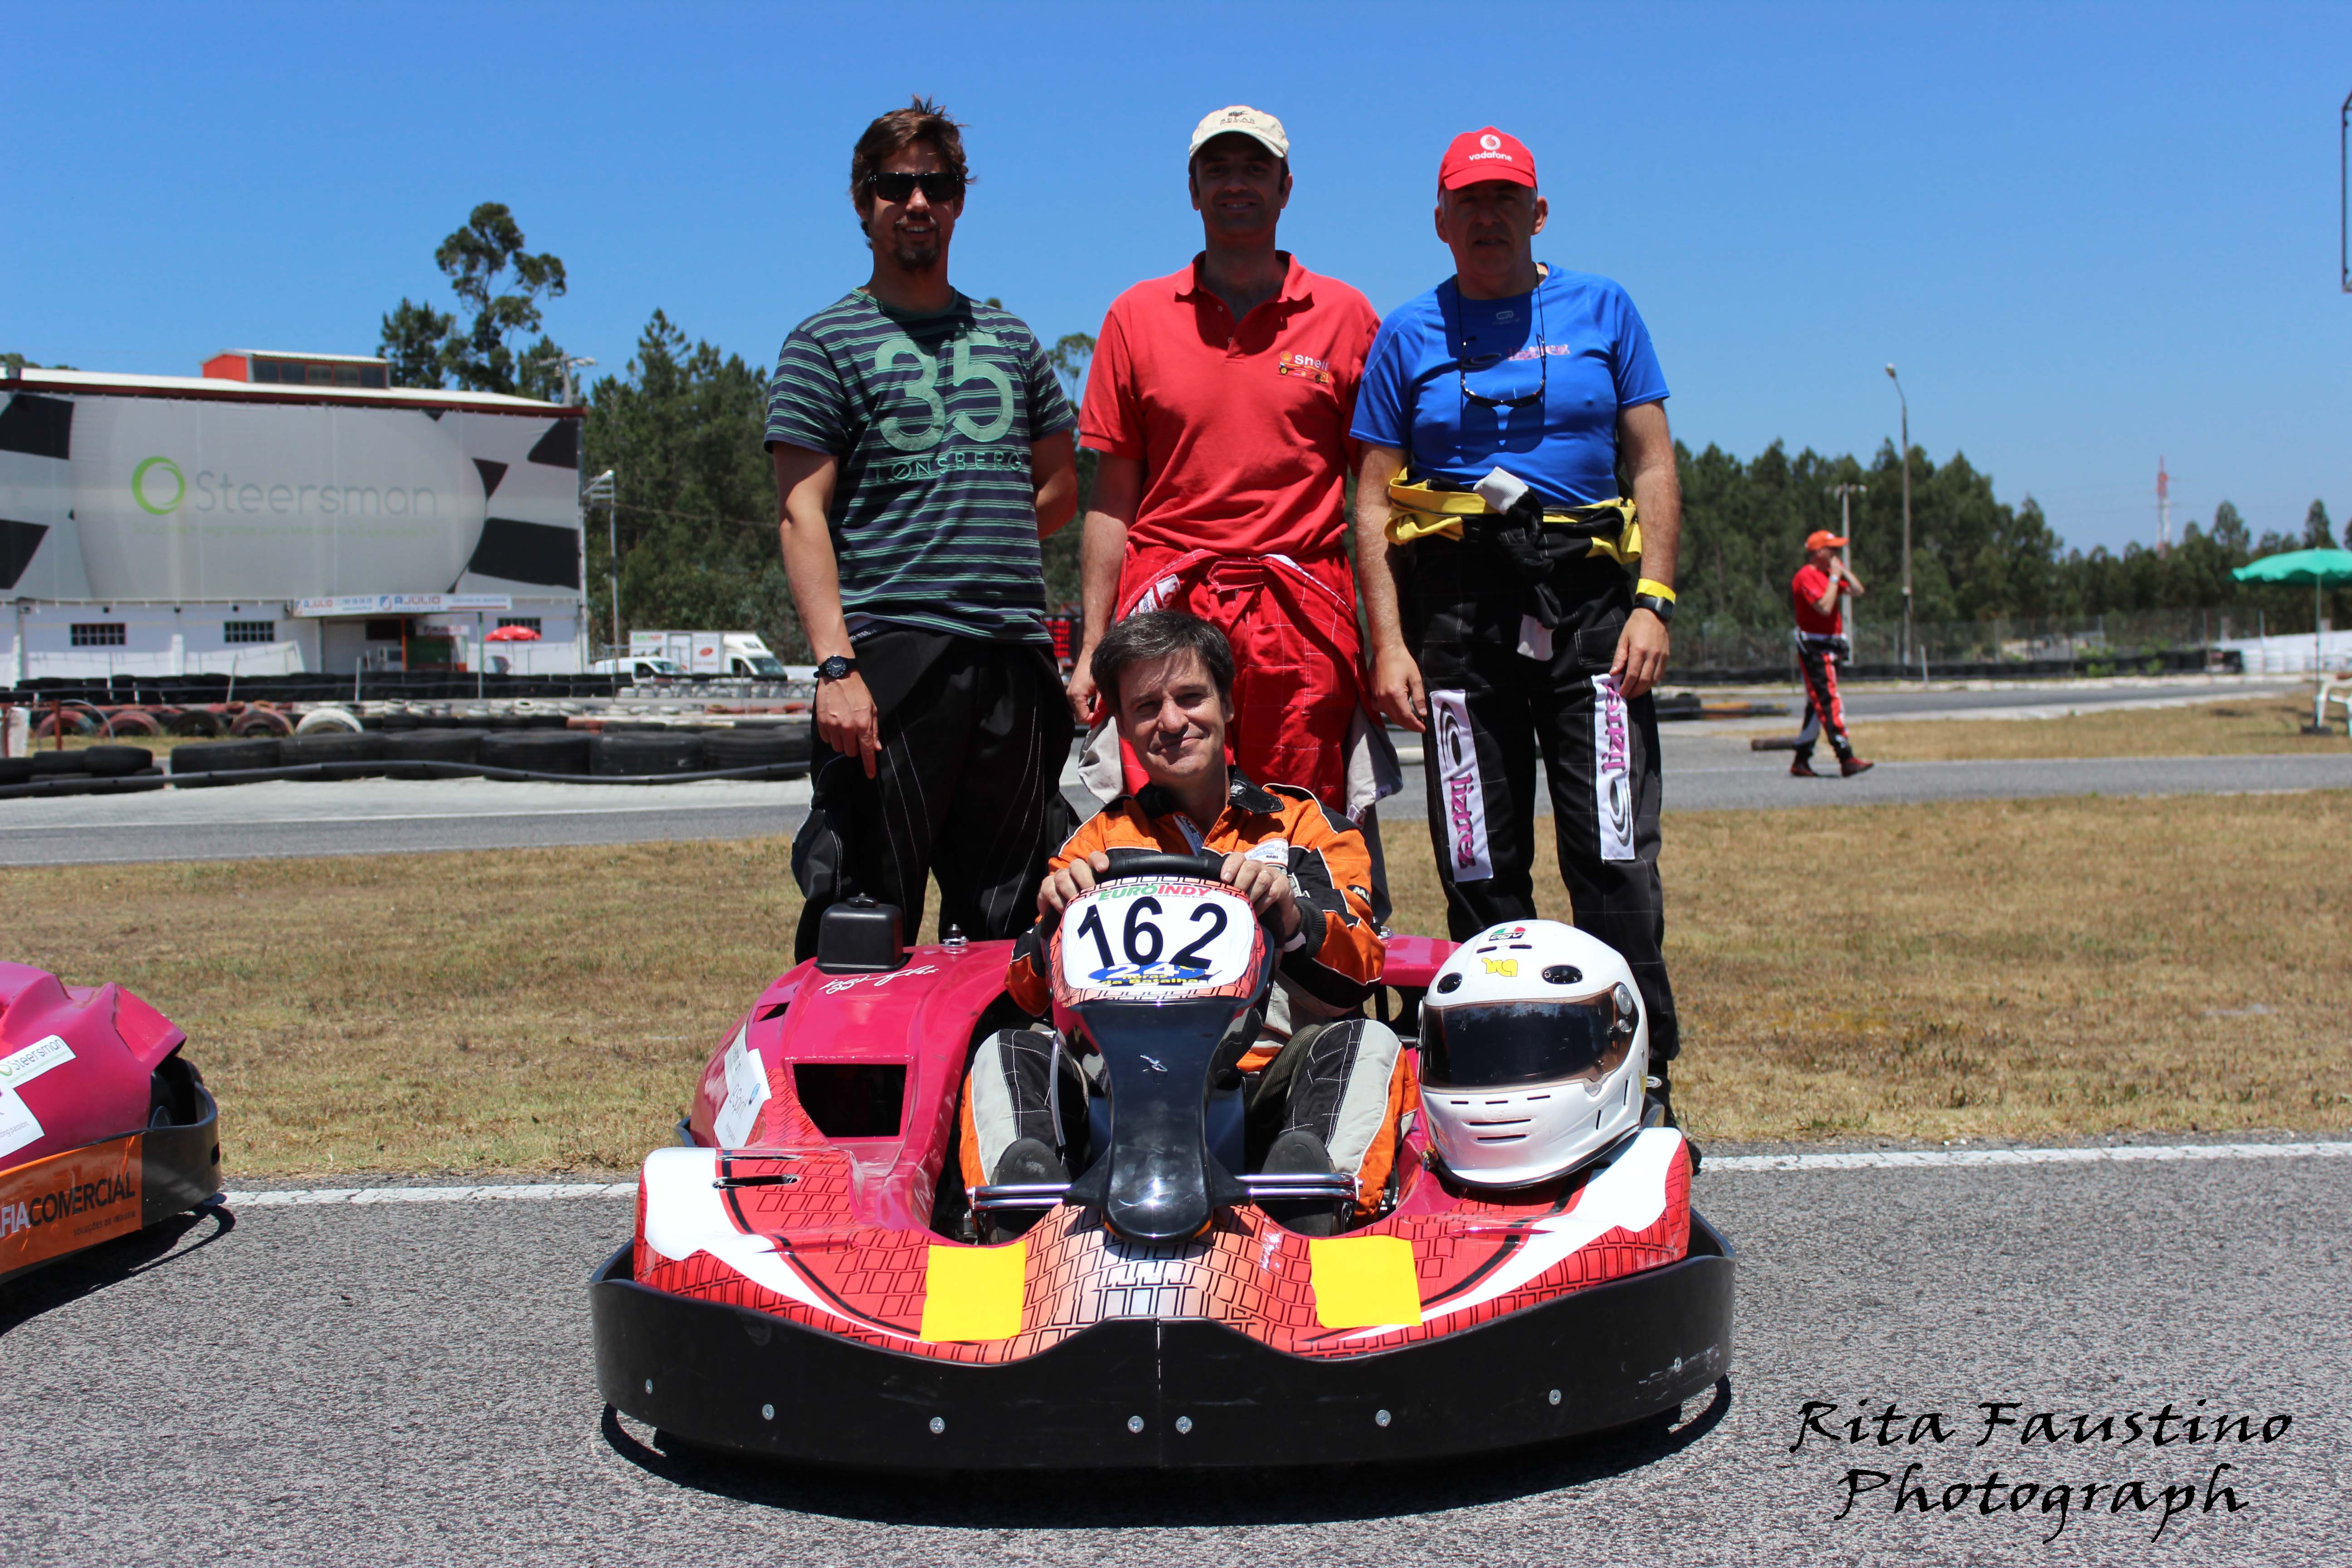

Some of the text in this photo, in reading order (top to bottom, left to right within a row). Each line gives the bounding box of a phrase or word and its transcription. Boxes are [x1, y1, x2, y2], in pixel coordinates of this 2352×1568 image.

[1468, 151, 1513, 162] vodafone
[874, 331, 1014, 451] 35
[196, 470, 438, 516] Steersman
[1098, 885, 1211, 901] EUROINDY
[1077, 897, 1227, 969] 162
[1105, 962, 1180, 979] 24
[7, 1039, 65, 1071] Steersman
